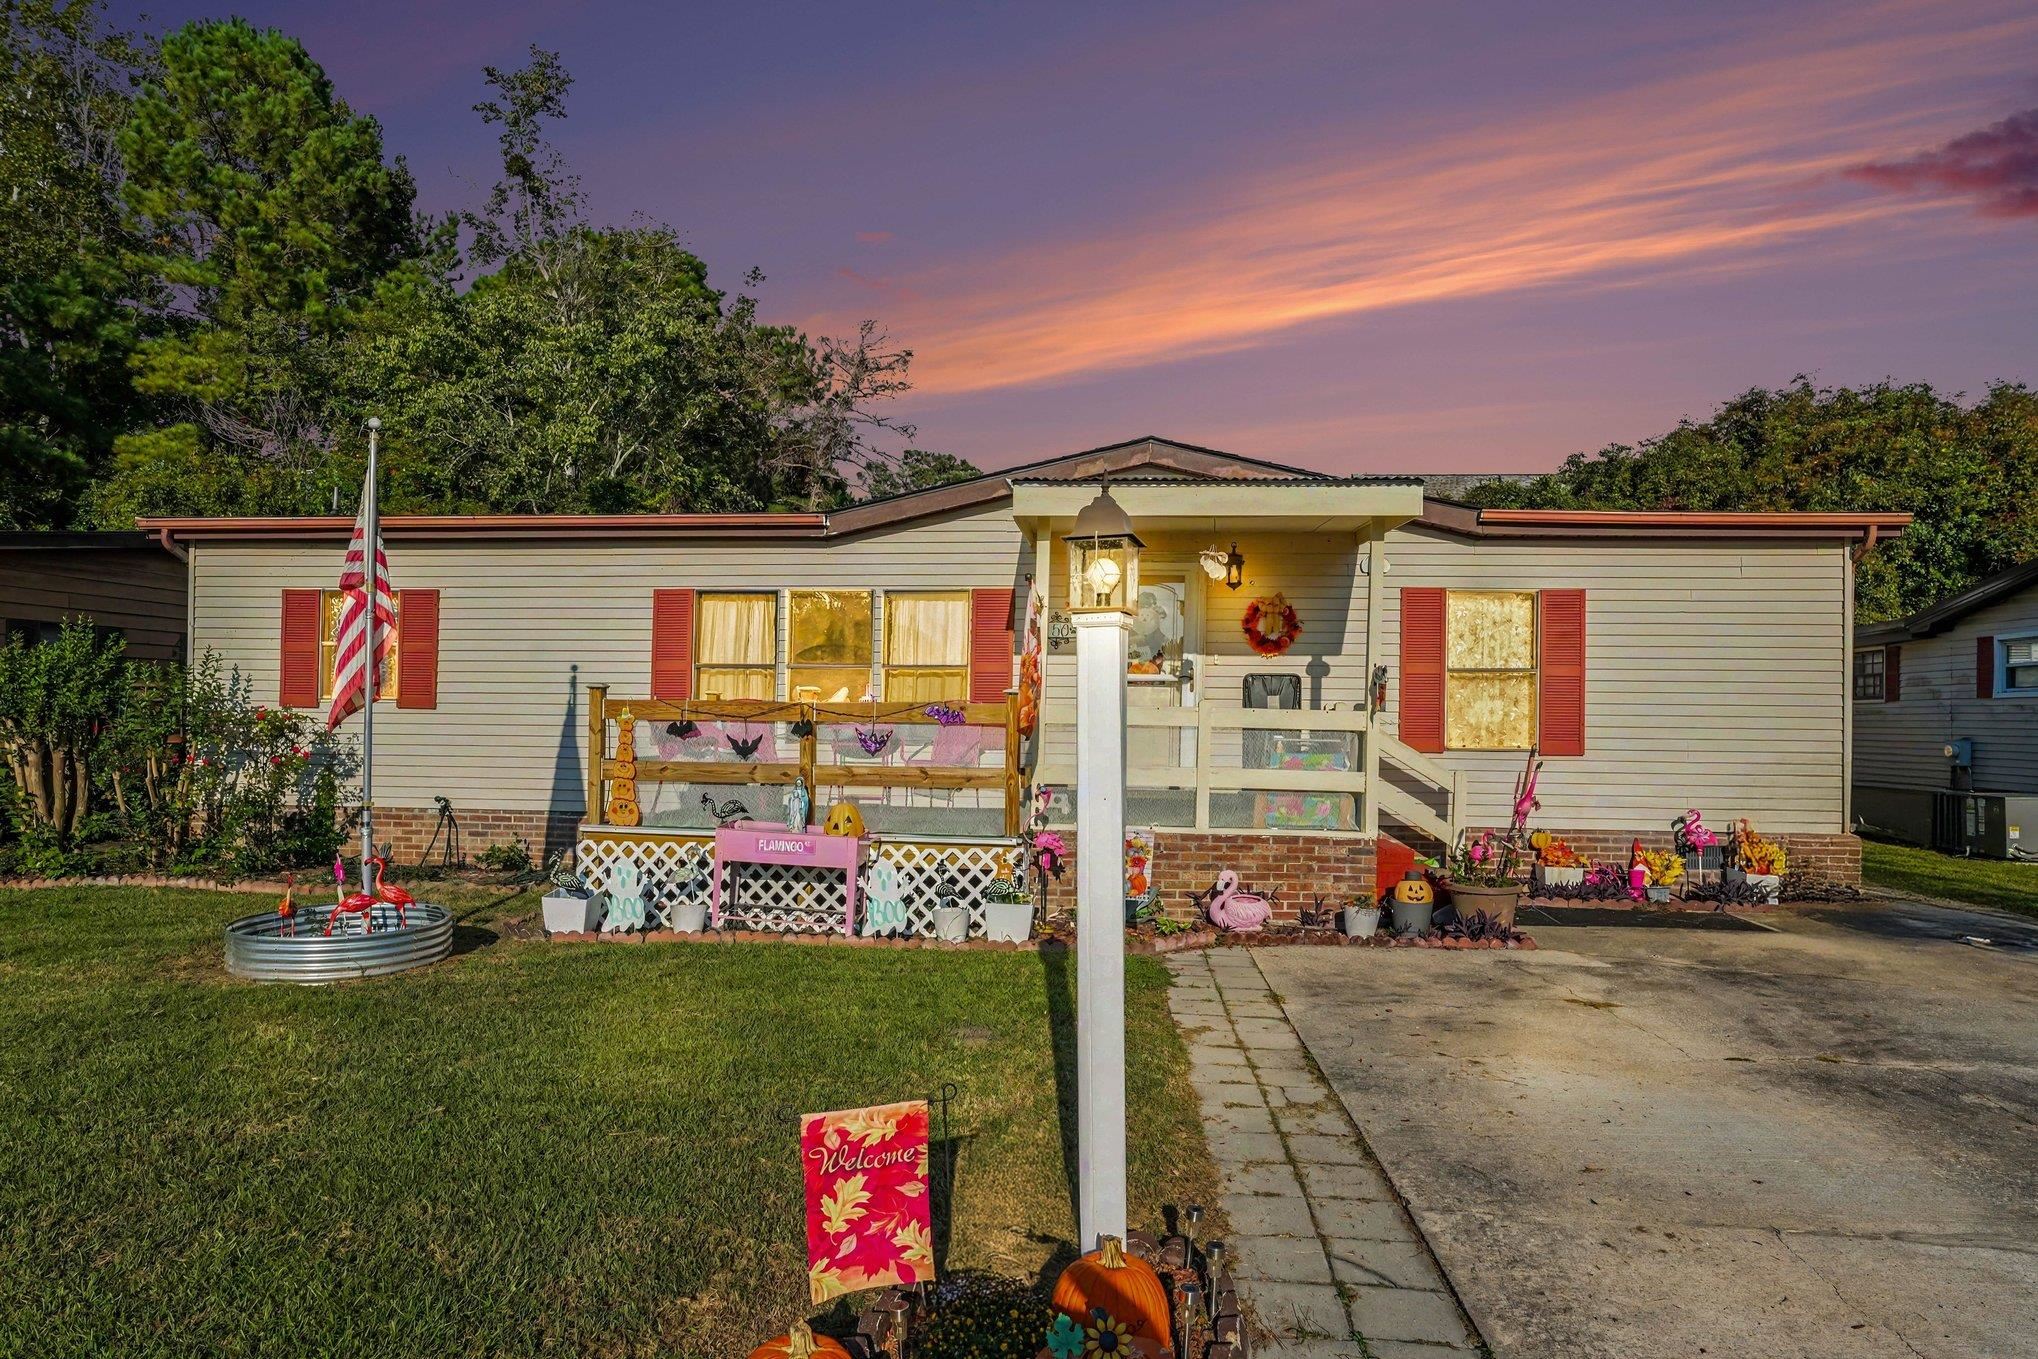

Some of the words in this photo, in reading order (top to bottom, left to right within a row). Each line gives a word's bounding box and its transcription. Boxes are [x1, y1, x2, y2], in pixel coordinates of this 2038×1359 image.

[758, 839, 804, 852] FLAMINGO
[610, 895, 644, 924] BOO
[869, 898, 905, 927] BOO
[808, 1144, 916, 1176] Welcome
